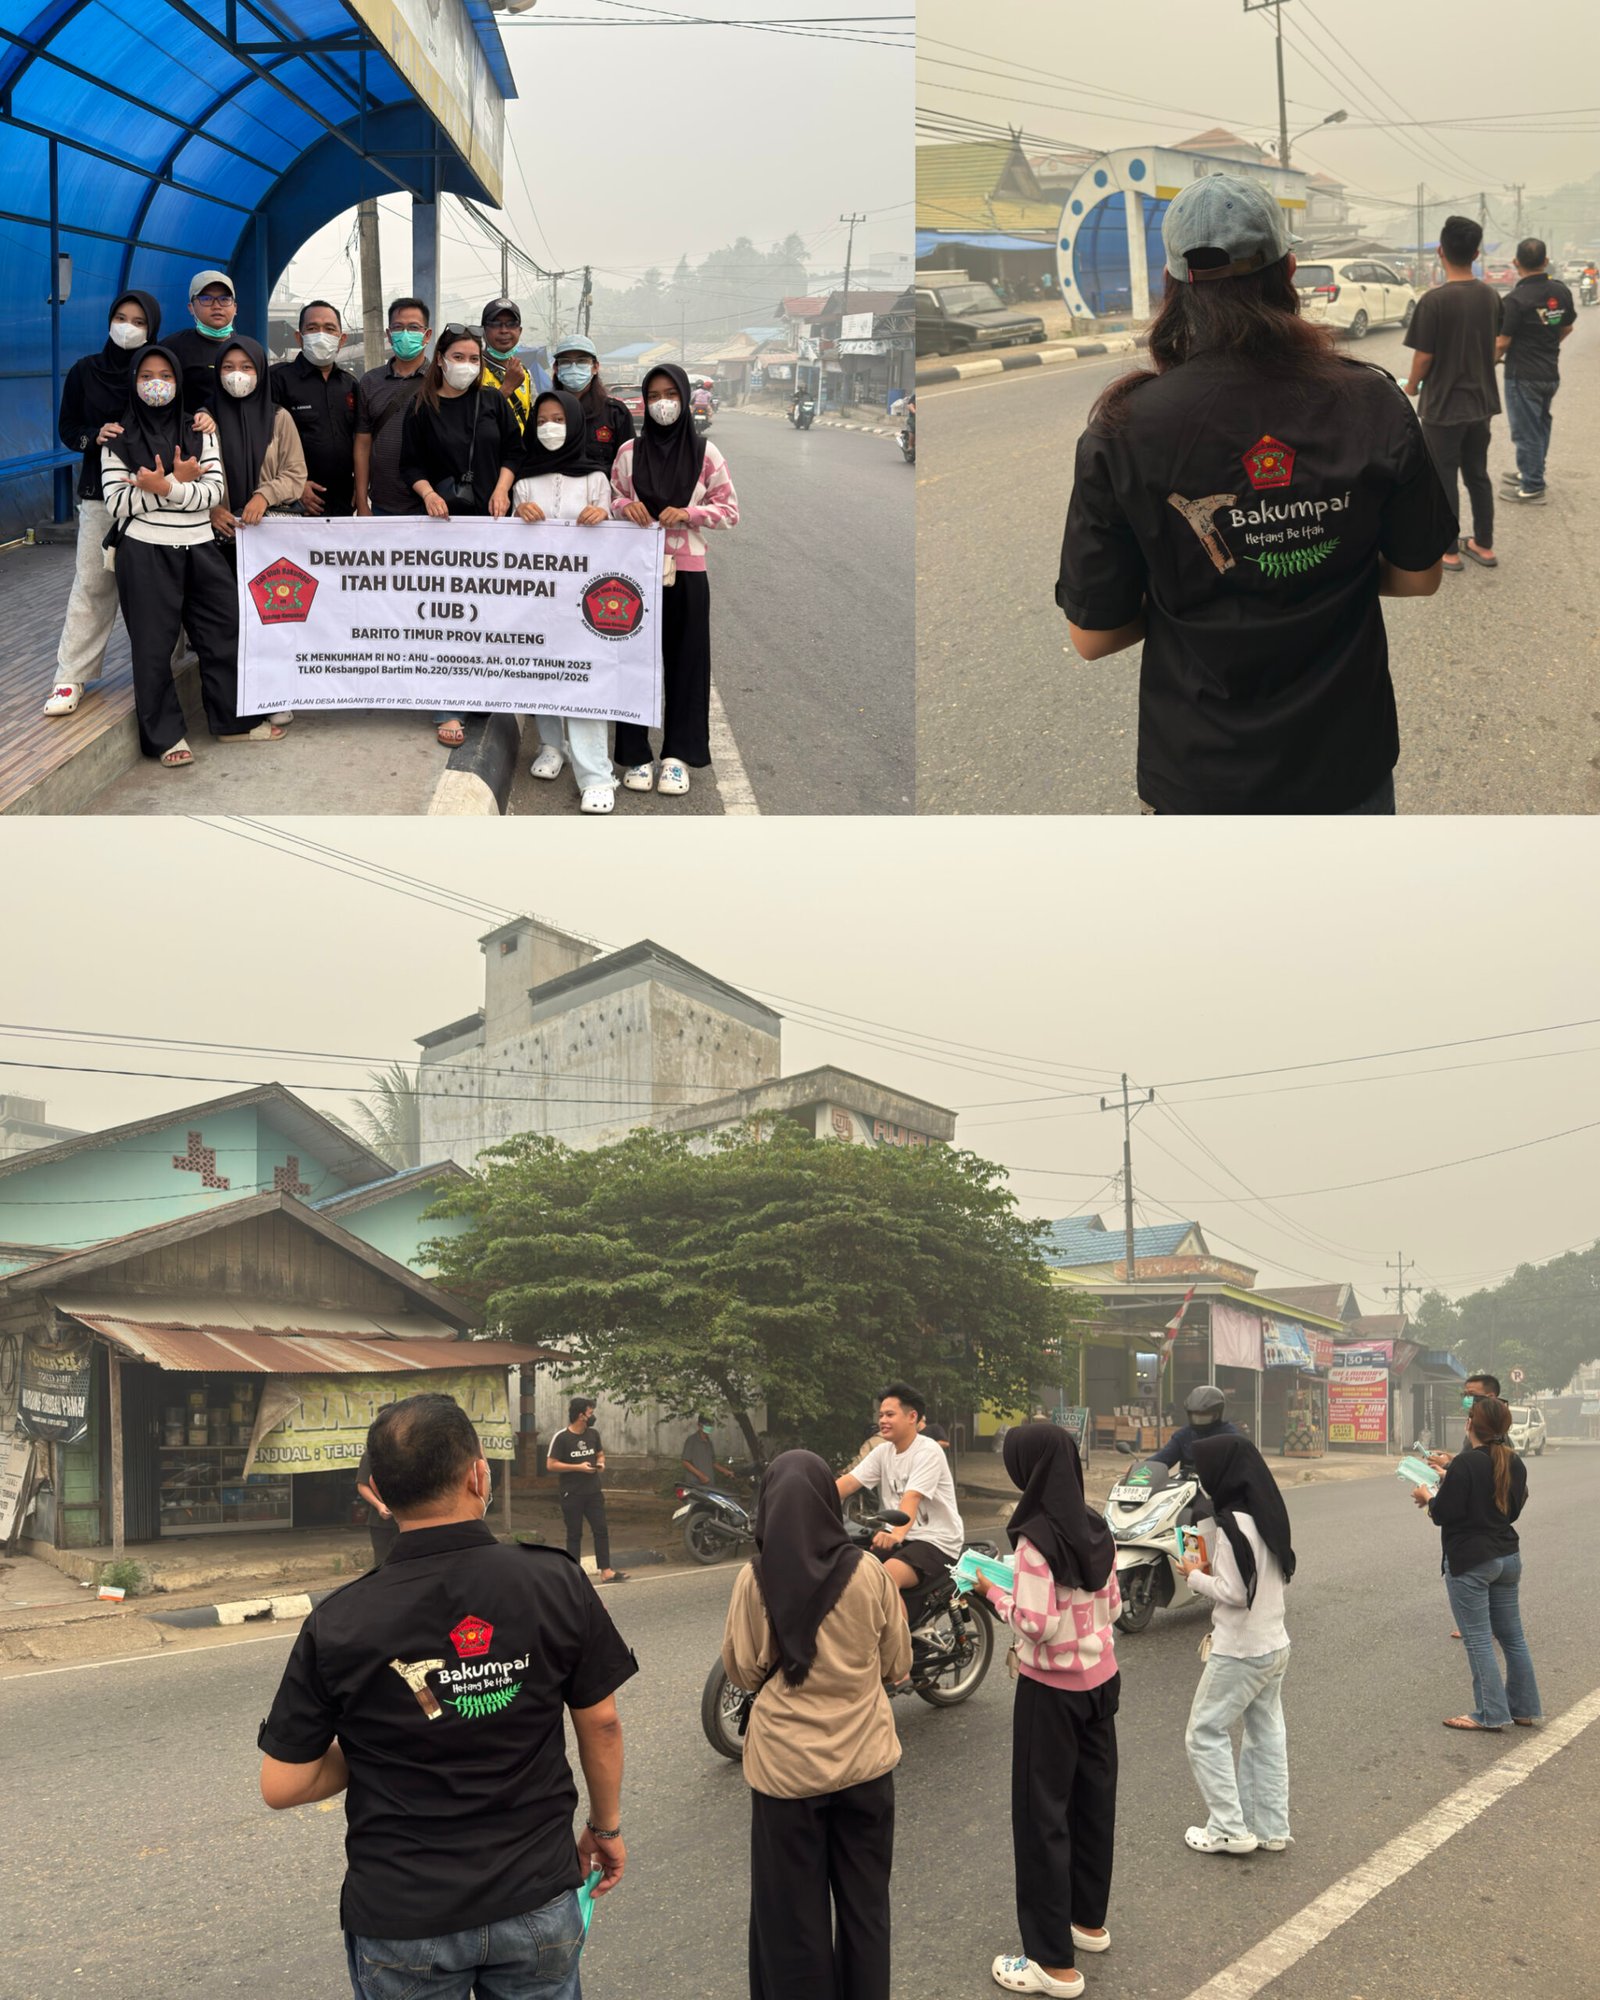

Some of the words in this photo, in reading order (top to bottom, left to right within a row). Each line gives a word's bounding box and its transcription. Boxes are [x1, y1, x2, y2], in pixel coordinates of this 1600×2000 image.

[1229, 491, 1351, 528] Bakumpai
[1246, 532, 1284, 546] Hetang
[1287, 528, 1300, 540] Be
[310, 550, 384, 566] DEWAN
[392, 551, 498, 568] PENGURUS
[504, 554, 588, 572] DAERAH
[341, 575, 386, 591] ITAH
[393, 576, 444, 592] ULUH
[451, 576, 555, 597] BAKUMPAI
[418, 602, 425, 620] (
[431, 602, 464, 618] IUB
[470, 604, 478, 622] )
[352, 628, 400, 640] BARITO
[403, 629, 443, 640] TIMUR
[447, 631, 481, 642] PROV
[485, 633, 544, 645] KALTENG
[296, 654, 308, 662] SK
[311, 654, 372, 662] MENKUMHAM
[375, 654, 384, 662] RI
[387, 654, 400, 662] NO
[409, 654, 428, 662] AHU
[437, 655, 483, 664] 0000043.
[505, 658, 530, 666] 01.07
[533, 659, 565, 668] TAHUN
[567, 661, 592, 670] 2023
[299, 665, 322, 674] TLKO
[325, 665, 379, 676] Kesbangpol
[382, 666, 412, 674] Bartim
[258, 700, 286, 709] ALAMAT
[560, 705, 607, 715] KALIMANTAN
[610, 709, 640, 719] TENGAH
[256, 1445, 311, 1464] ENJUAL
[570, 1448, 595, 1458] CELCIUS
[437, 1653, 530, 1684] Bakumpai
[452, 1682, 482, 1694] Hetang
[483, 1678, 494, 1688] Be
